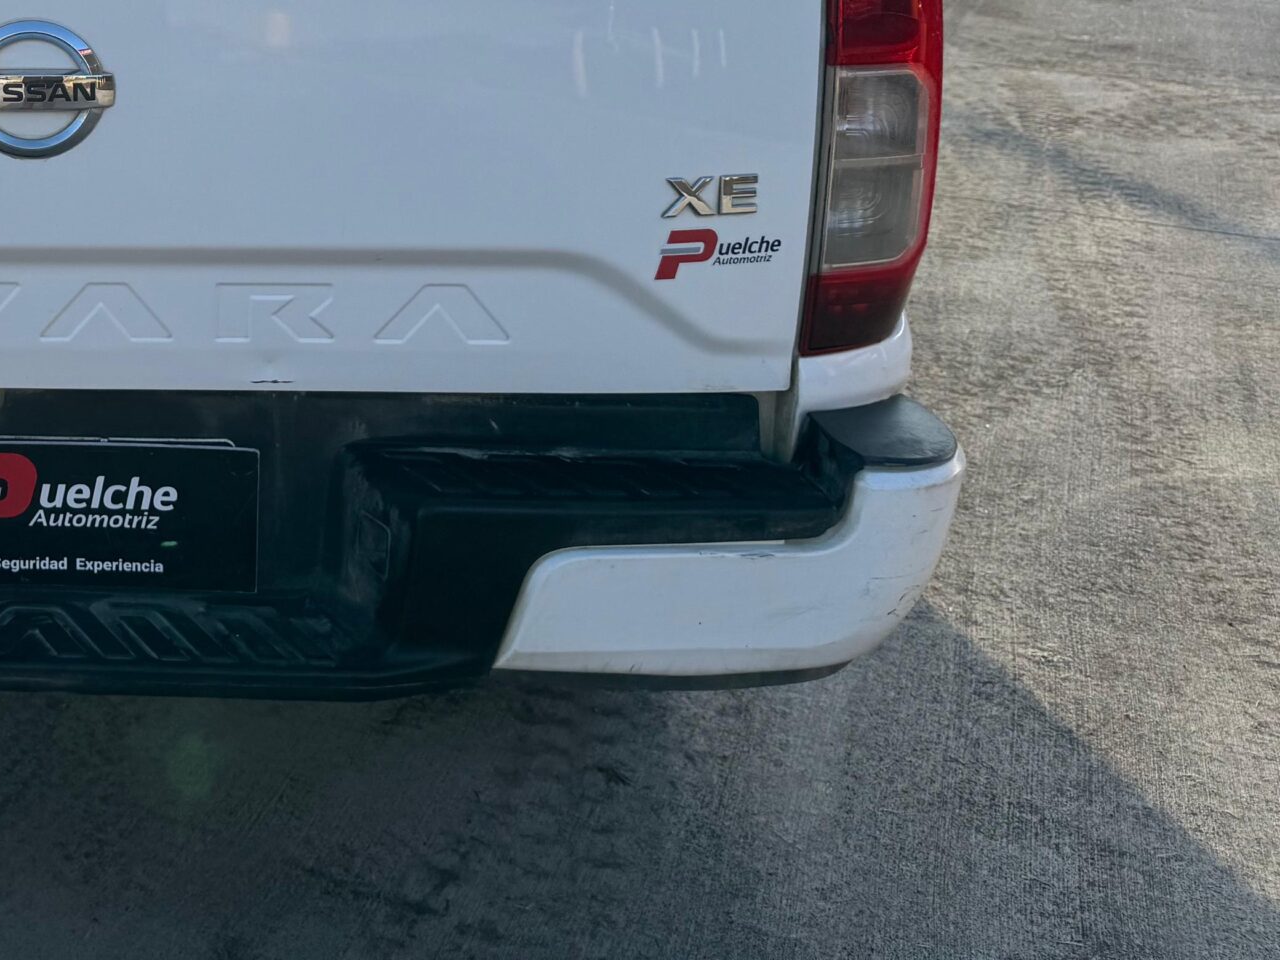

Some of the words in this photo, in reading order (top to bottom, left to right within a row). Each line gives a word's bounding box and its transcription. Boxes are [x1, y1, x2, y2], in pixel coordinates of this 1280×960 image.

[661, 173, 759, 218] XE
[654, 228, 782, 280] Puelche
[712, 254, 773, 266] Automotriz
[28, 509, 161, 530] Automotriz
[75, 557, 165, 573] Experiencia
